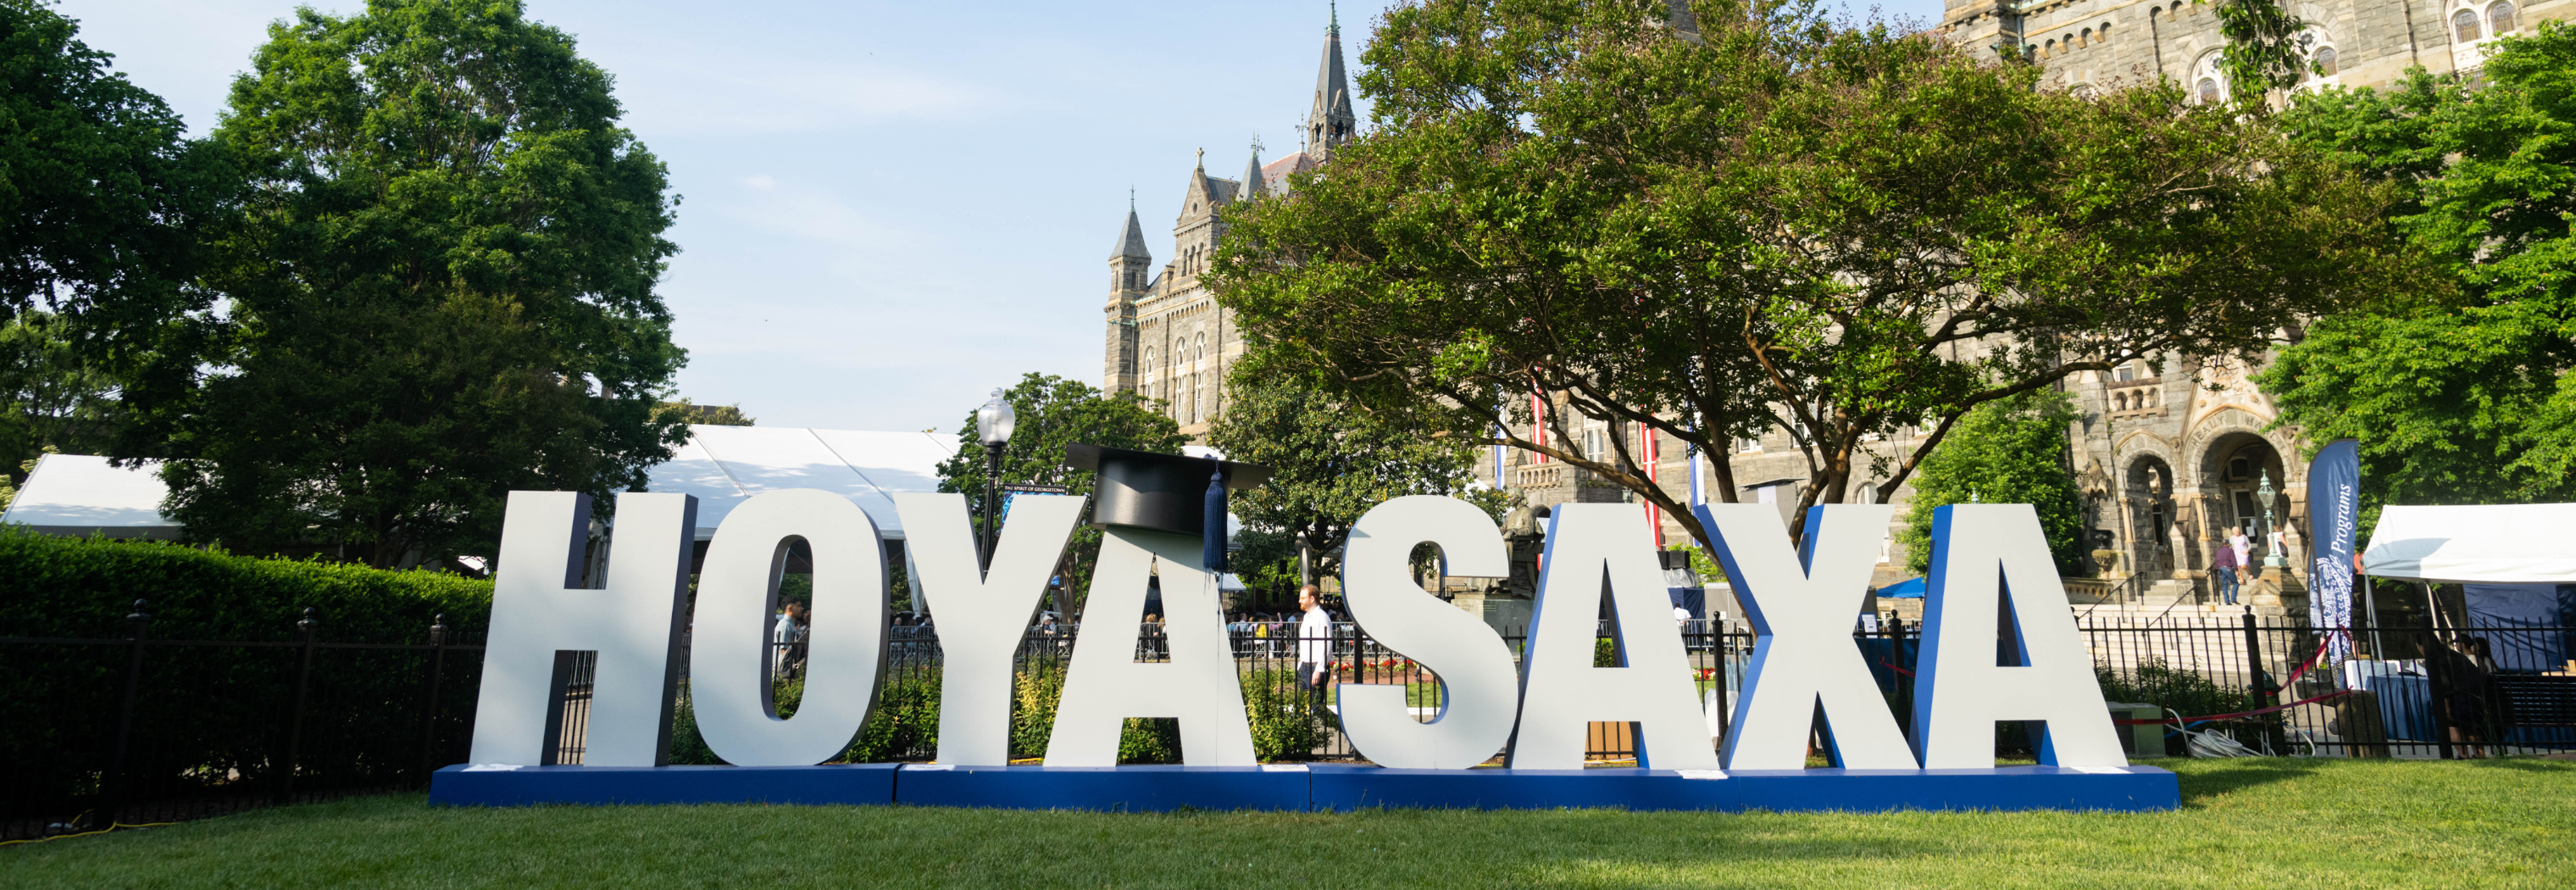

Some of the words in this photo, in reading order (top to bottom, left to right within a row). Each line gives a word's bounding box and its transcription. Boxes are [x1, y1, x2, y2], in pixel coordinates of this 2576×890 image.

[2190, 416, 2223, 447] HEALY
[2246, 417, 2276, 441] HAL
[2331, 483, 2352, 555] Programs
[469, 487, 1257, 767] HOYA
[1336, 494, 2129, 770] SAXA
